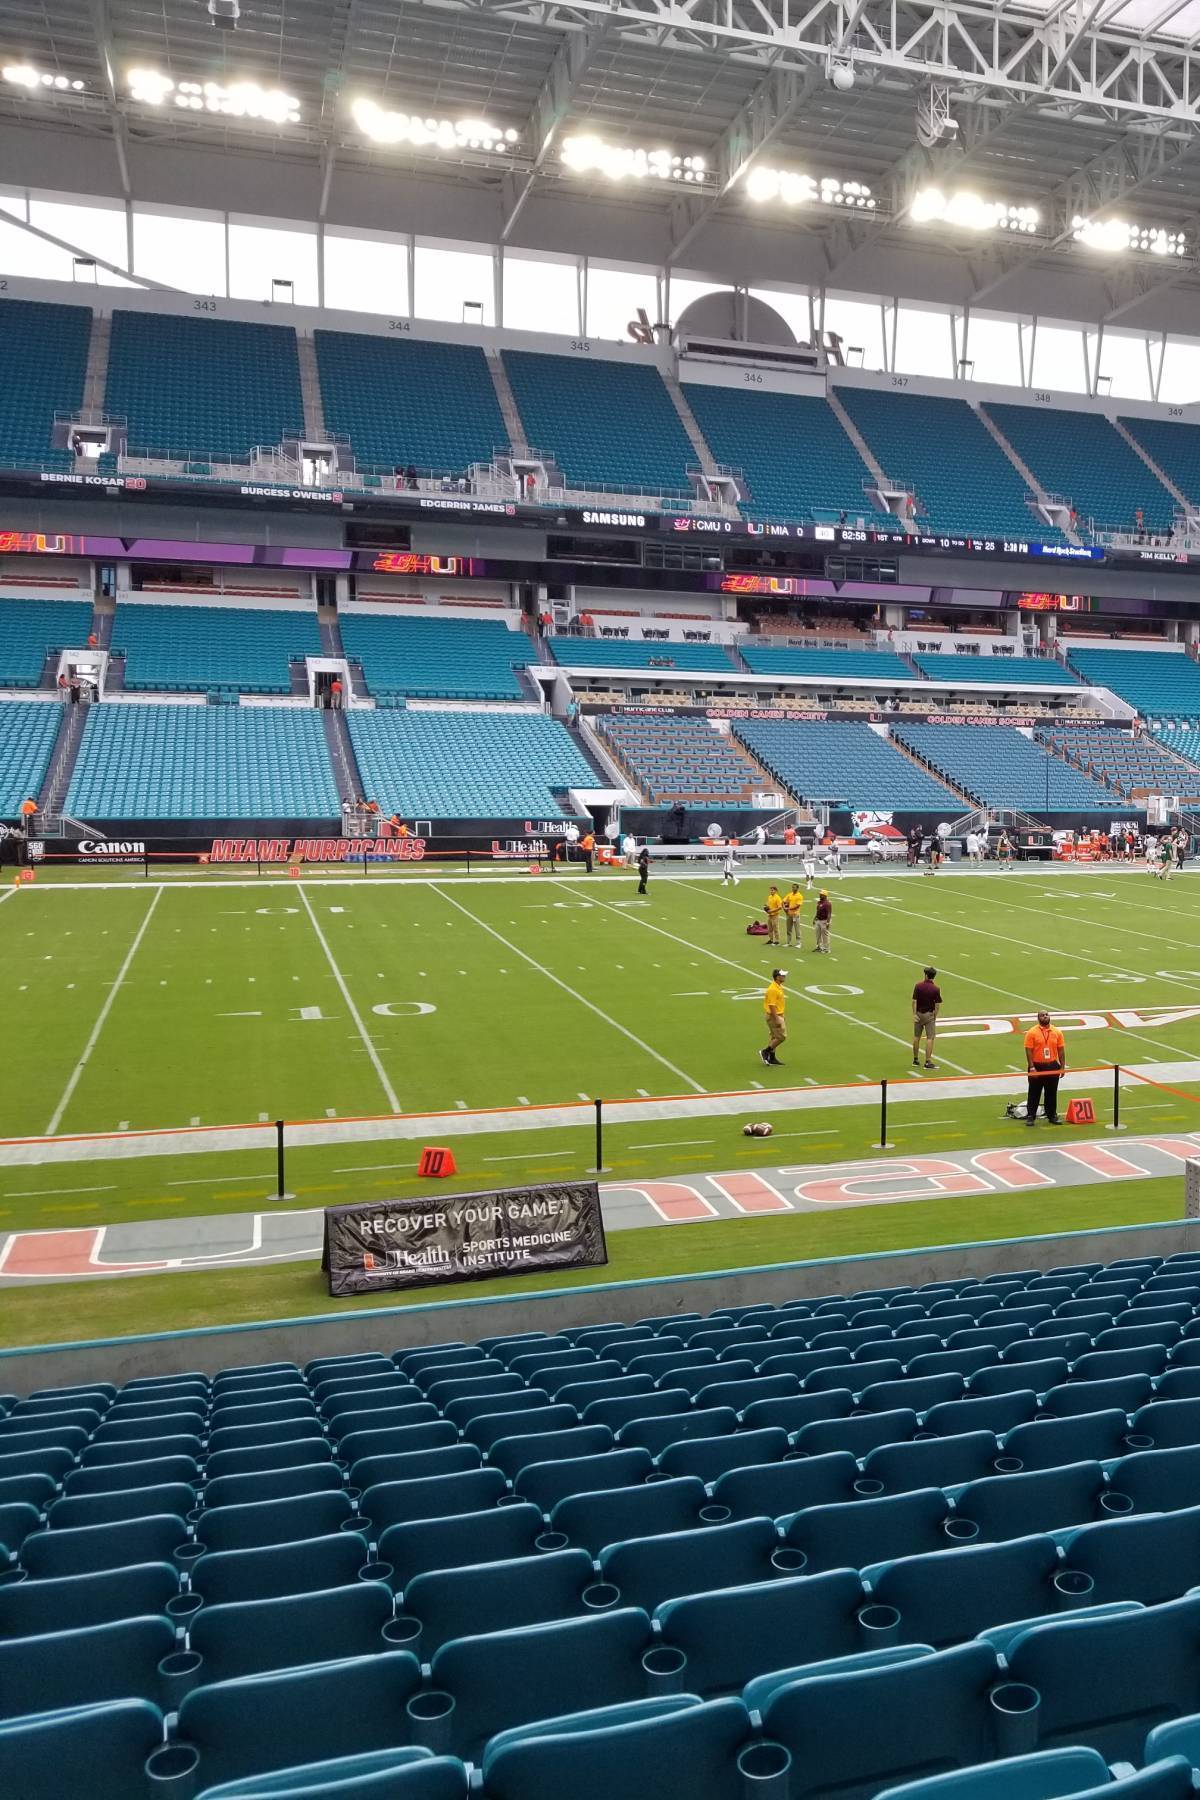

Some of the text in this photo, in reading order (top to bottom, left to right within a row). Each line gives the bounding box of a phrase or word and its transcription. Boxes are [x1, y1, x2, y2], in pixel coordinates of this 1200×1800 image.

[194, 300, 216, 312] 343
[388, 320, 410, 332] 344
[570, 340, 590, 352] 345
[743, 373, 763, 384] 346
[891, 376, 909, 388] 347
[1035, 392, 1051, 403] 348
[1168, 407, 1183, 418] 349
[41, 473, 83, 483] BERNIE
[85, 476, 124, 487] KOSAR
[241, 486, 290, 498] BURGESS
[292, 490, 332, 501] OWENS
[420, 499, 505, 513] EDGERRIN JAMES
[582, 511, 645, 527] SAMSUNG
[696, 520, 720, 531] CMU
[771, 524, 789, 536] MIA
[877, 534, 888, 542] 1ST
[940, 538, 950, 547] 10
[985, 542, 995, 551] 25
[1140, 551, 1177, 561] JIM KELLY
[706, 708, 828, 721] GOLDEN CANES SOCIETY
[927, 715, 1036, 727] GOLDEN CANES SOCIETY
[78, 840, 145, 853] Canon
[210, 839, 426, 862] MIAMI HURRICANES
[289, 1002, 437, 1020] 10
[1073, 1101, 1094, 1121] 20
[423, 1151, 445, 1174] 10
[360, 1212, 447, 1236] RECOVER
[452, 1206, 503, 1226] YOUR
[462, 1230, 572, 1253] SPORTS MEDICINE
[462, 1249, 531, 1267] INSTITUTE
